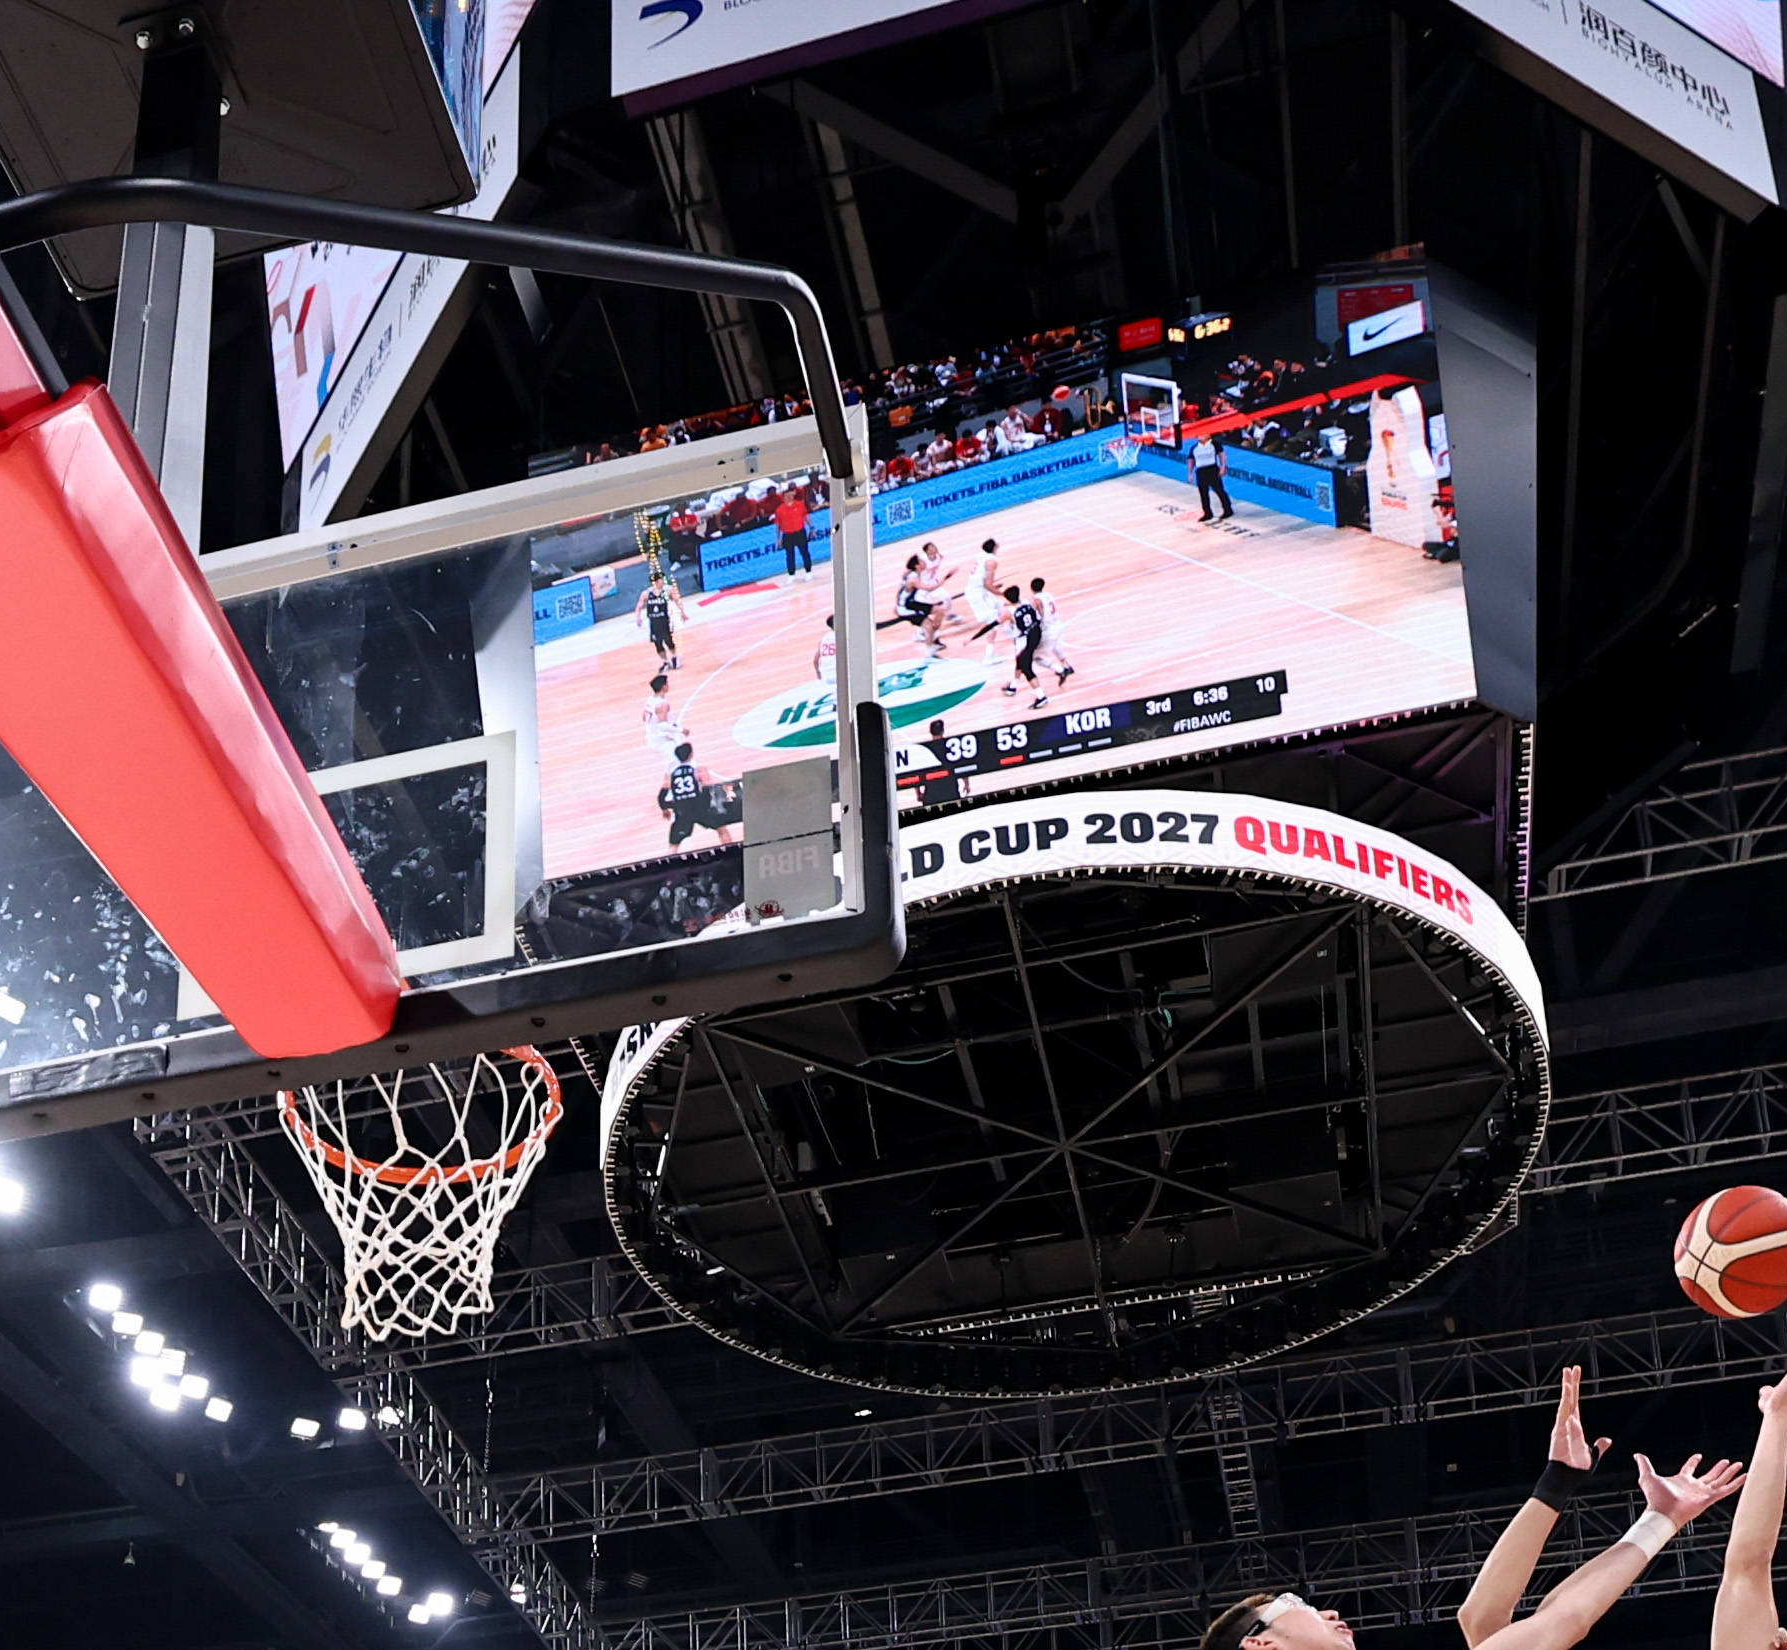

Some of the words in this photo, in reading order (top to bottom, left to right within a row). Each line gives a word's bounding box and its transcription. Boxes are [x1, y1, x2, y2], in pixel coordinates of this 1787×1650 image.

[1145, 697, 1172, 716] 3rd
[1193, 686, 1229, 706] 6:36
[1255, 677, 1276, 693] 10
[1064, 708, 1112, 735] KOR
[1172, 709, 1232, 733] #FIBAWC
[944, 738, 978, 762] 39
[995, 724, 1028, 751] 53
[673, 775, 696, 795] 33
[958, 816, 1069, 865] CUP
[1084, 811, 1220, 846] 2027
[1233, 814, 1474, 926] QUALIFIERS
